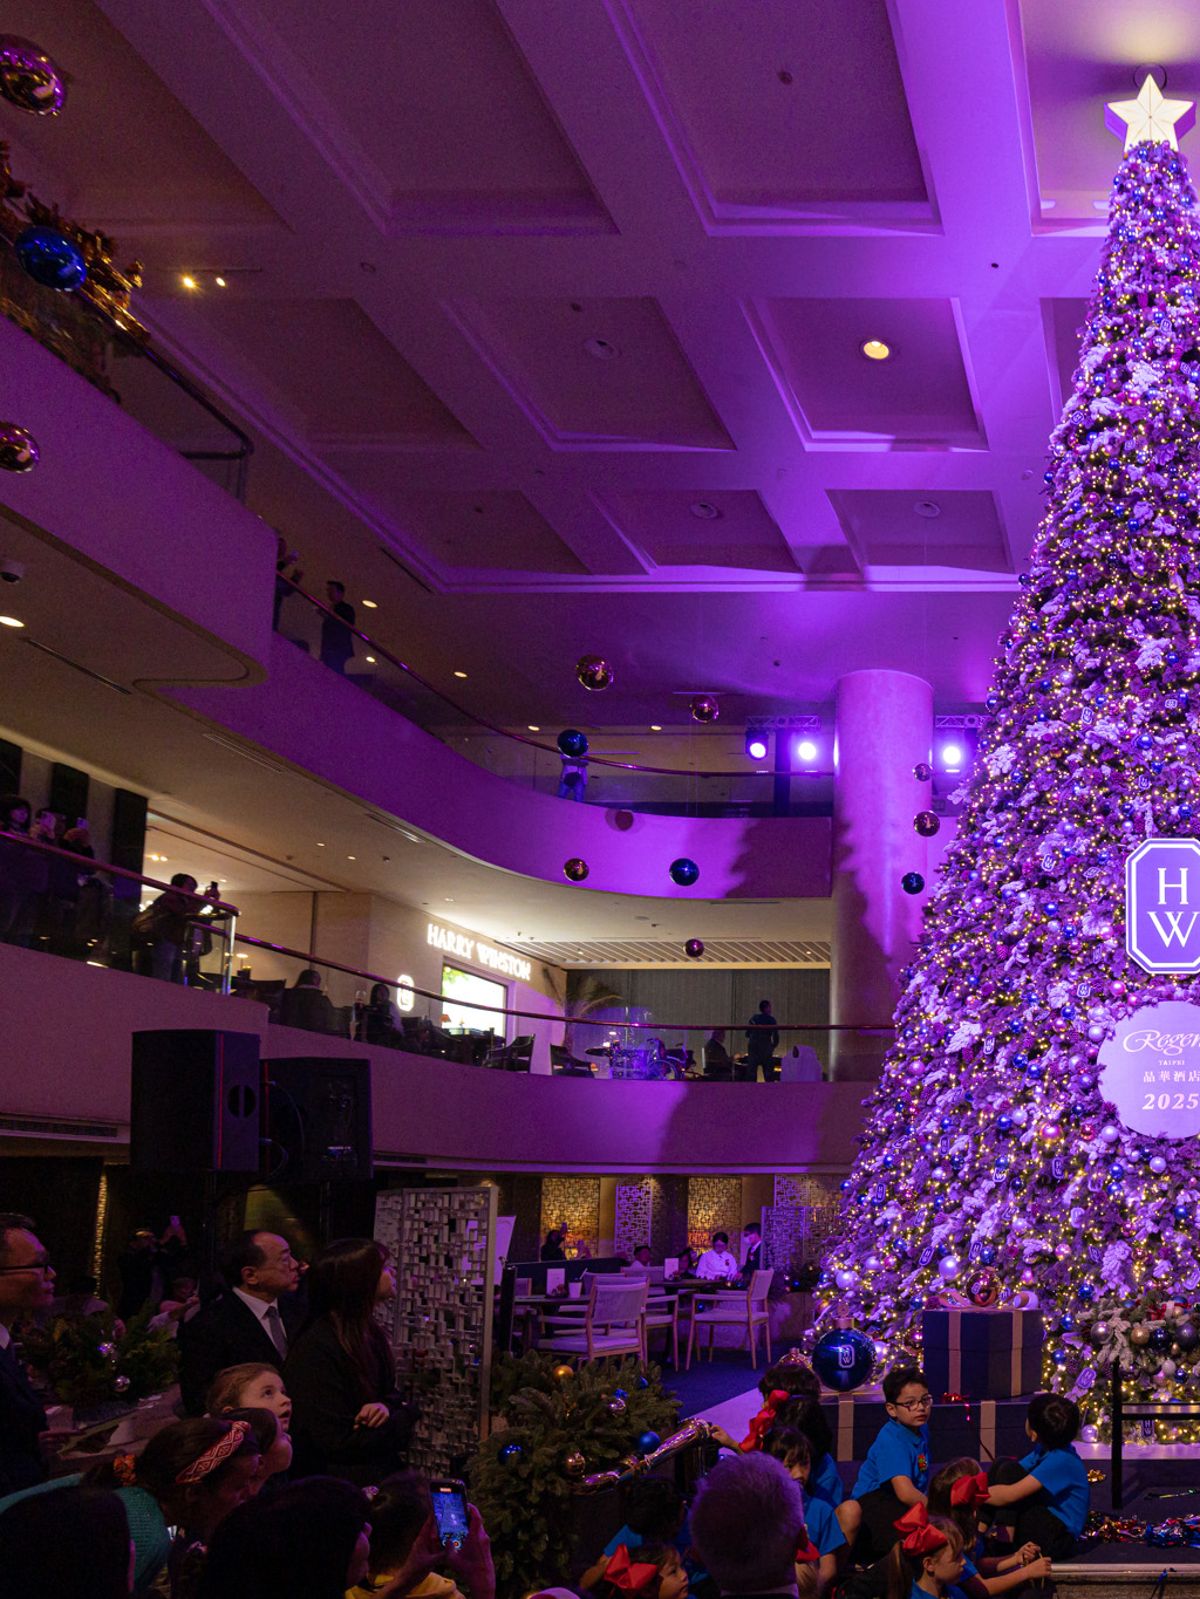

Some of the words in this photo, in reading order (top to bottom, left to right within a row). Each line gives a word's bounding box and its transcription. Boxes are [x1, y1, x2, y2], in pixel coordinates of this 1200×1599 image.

[1157, 867, 1189, 905] H
[1147, 911, 1200, 948] W
[427, 923, 475, 959] HARRY
[476, 942, 532, 981] WINSTON
[1142, 1093, 1199, 1110] 2025
